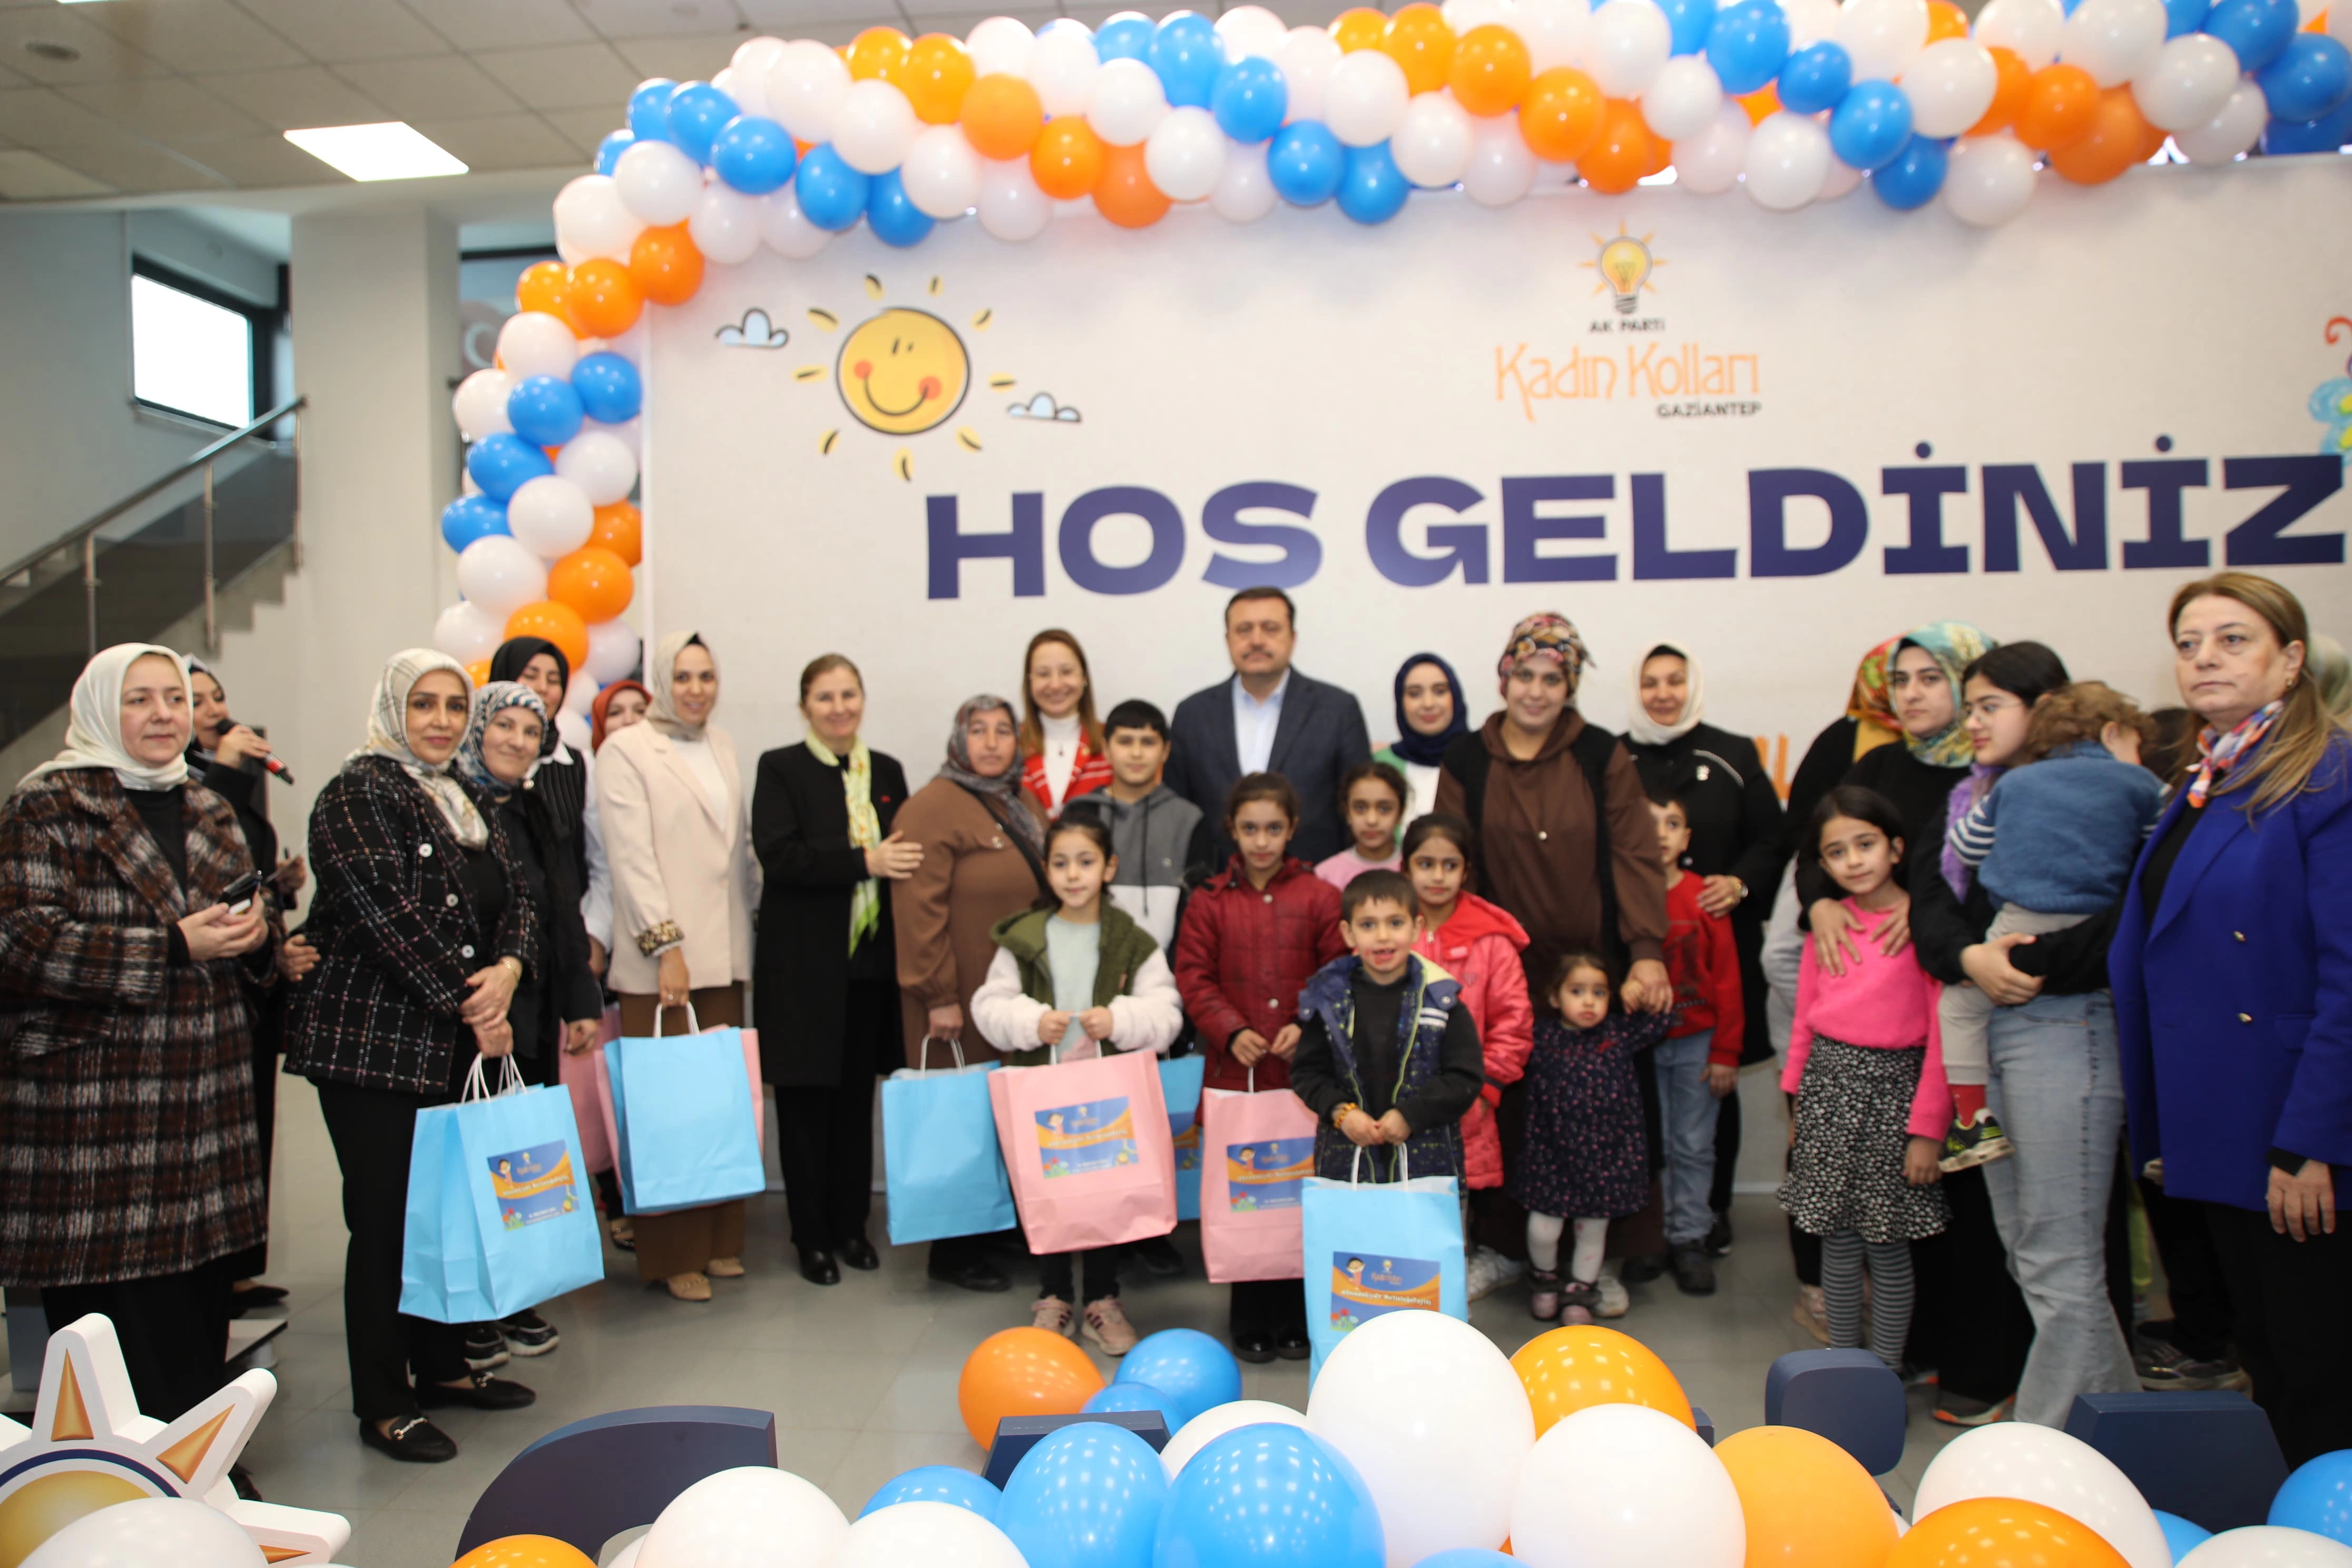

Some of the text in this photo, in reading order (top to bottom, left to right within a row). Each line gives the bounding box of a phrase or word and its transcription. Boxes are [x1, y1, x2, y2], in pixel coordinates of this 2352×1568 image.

[1589, 319, 1614, 334] AK
[1494, 341, 1761, 423] Kadın Kolları
[1656, 399, 1762, 419] GAZİANTEP
[1365, 433, 2346, 587] GELDİNİZ
